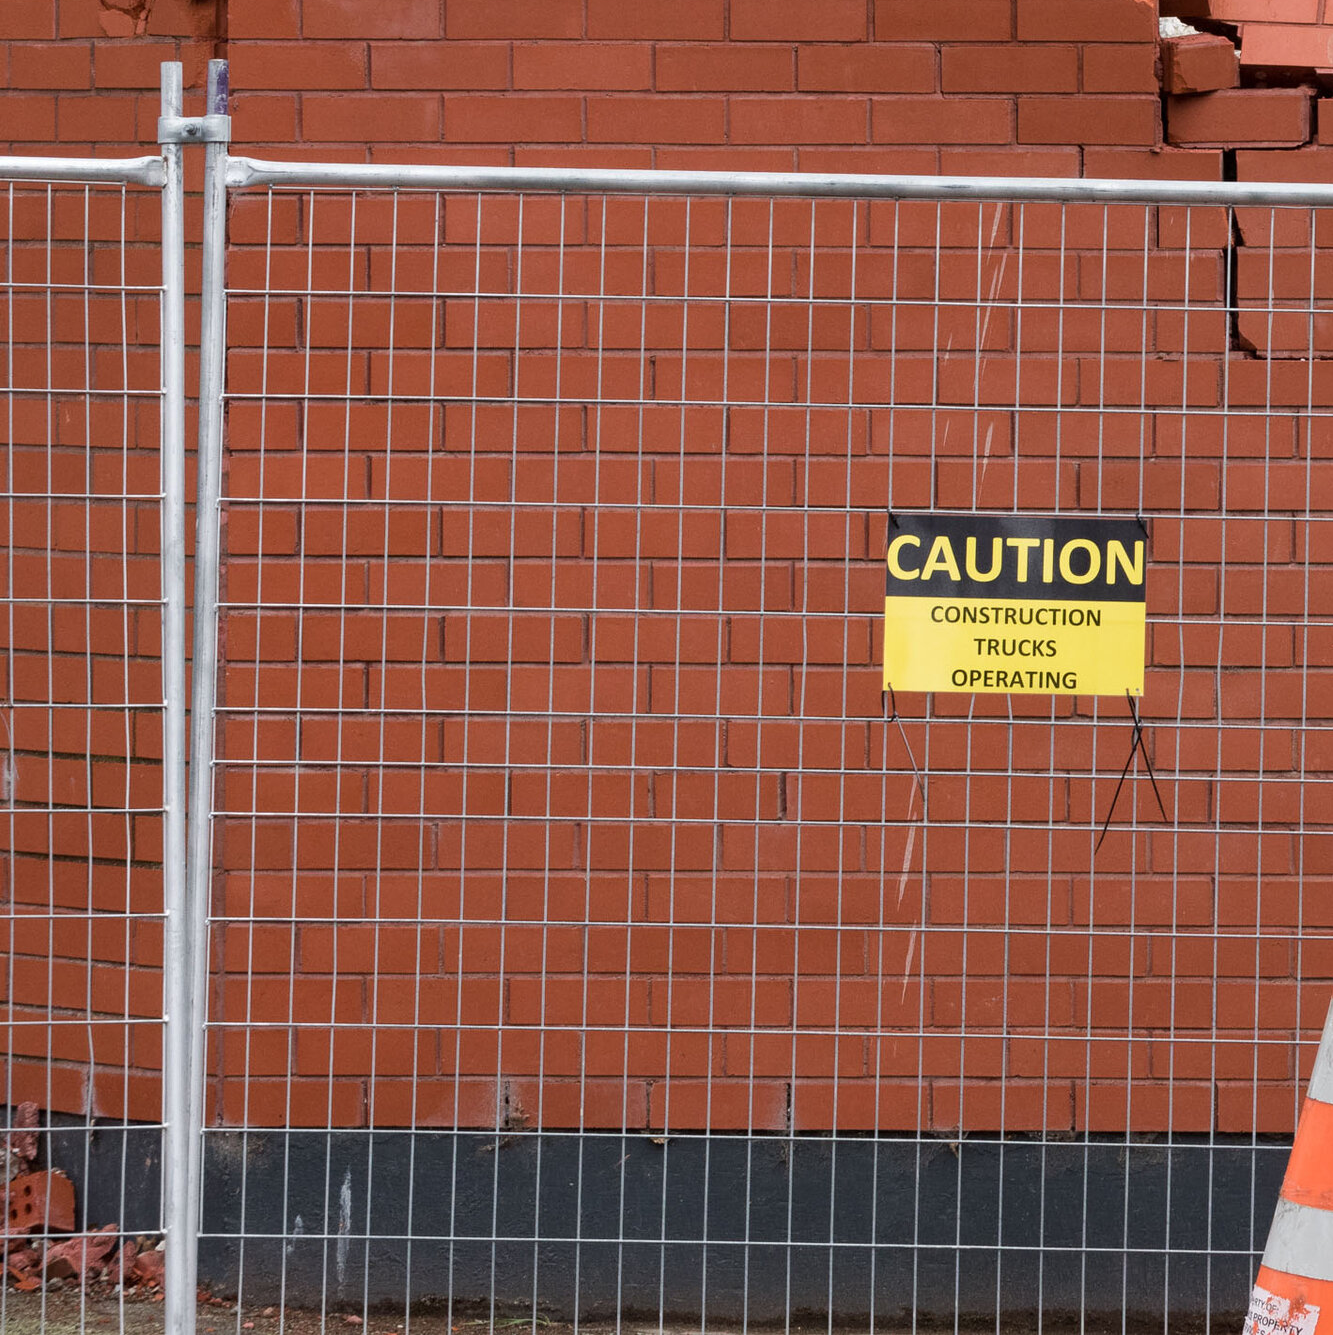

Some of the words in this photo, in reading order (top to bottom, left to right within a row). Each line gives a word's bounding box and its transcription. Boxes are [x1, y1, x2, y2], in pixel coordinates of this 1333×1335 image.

[887, 534, 1144, 586] CAUTION
[931, 605, 1102, 627] CONSTRUCTION
[973, 638, 1057, 657] TRUCKS
[951, 669, 1077, 690] OPERATING
[1253, 1312, 1303, 1335] PROPERTY
